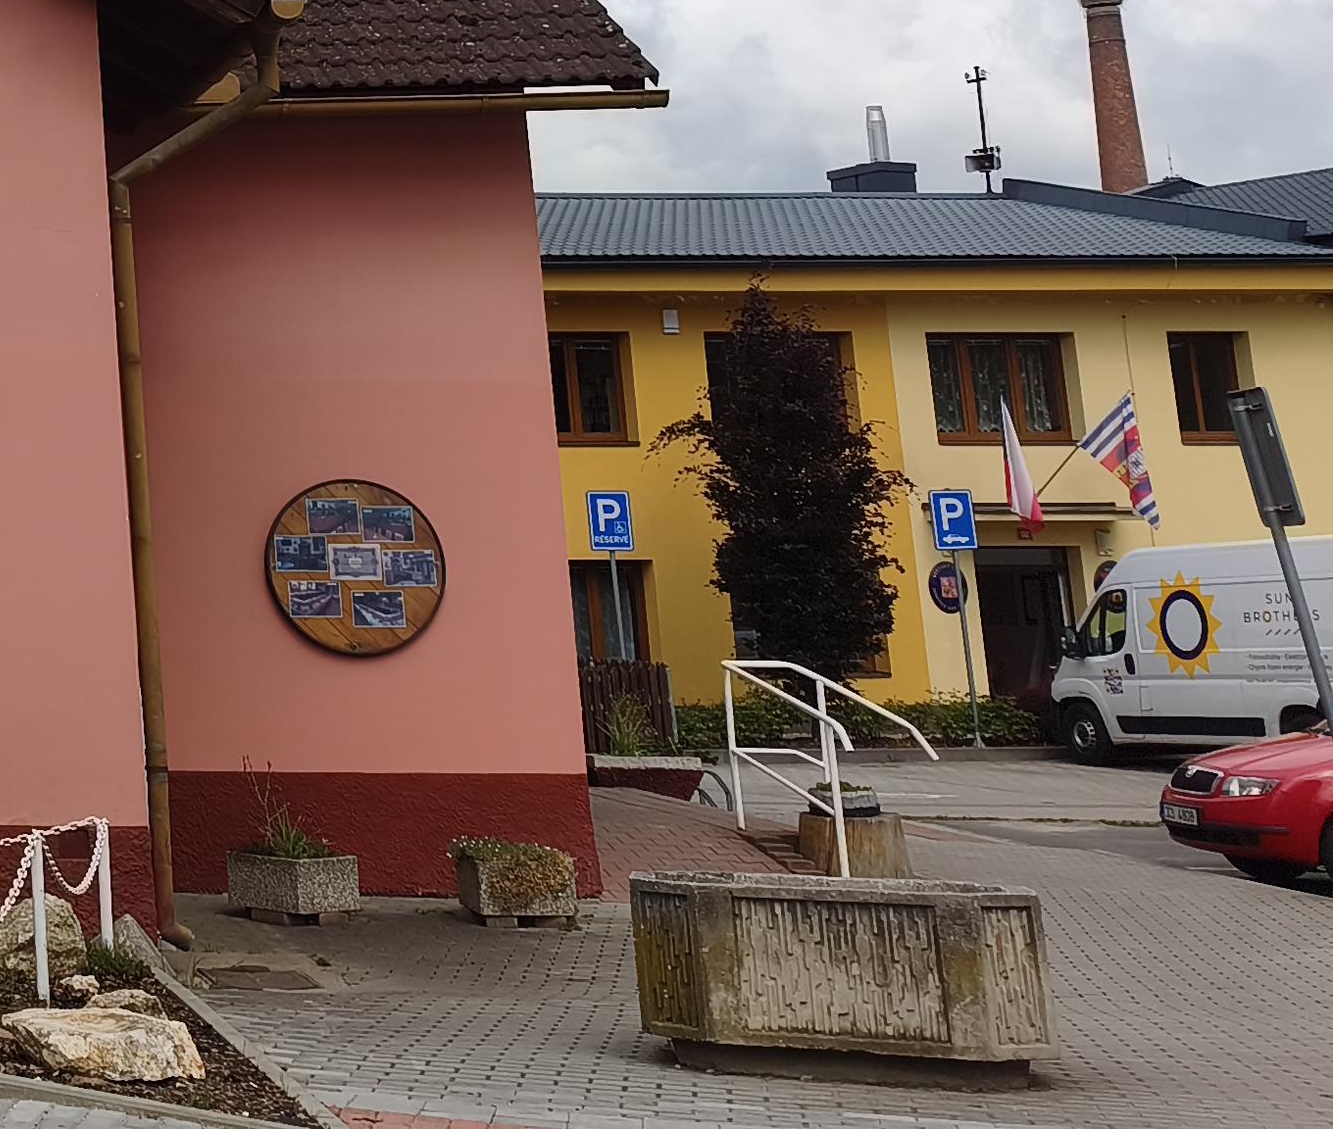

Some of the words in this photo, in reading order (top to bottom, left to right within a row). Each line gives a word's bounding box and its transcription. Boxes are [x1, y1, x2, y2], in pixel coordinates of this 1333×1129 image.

[596, 498, 621, 532] P
[939, 497, 964, 531] P
[1243, 609, 1320, 623] BROTHS
